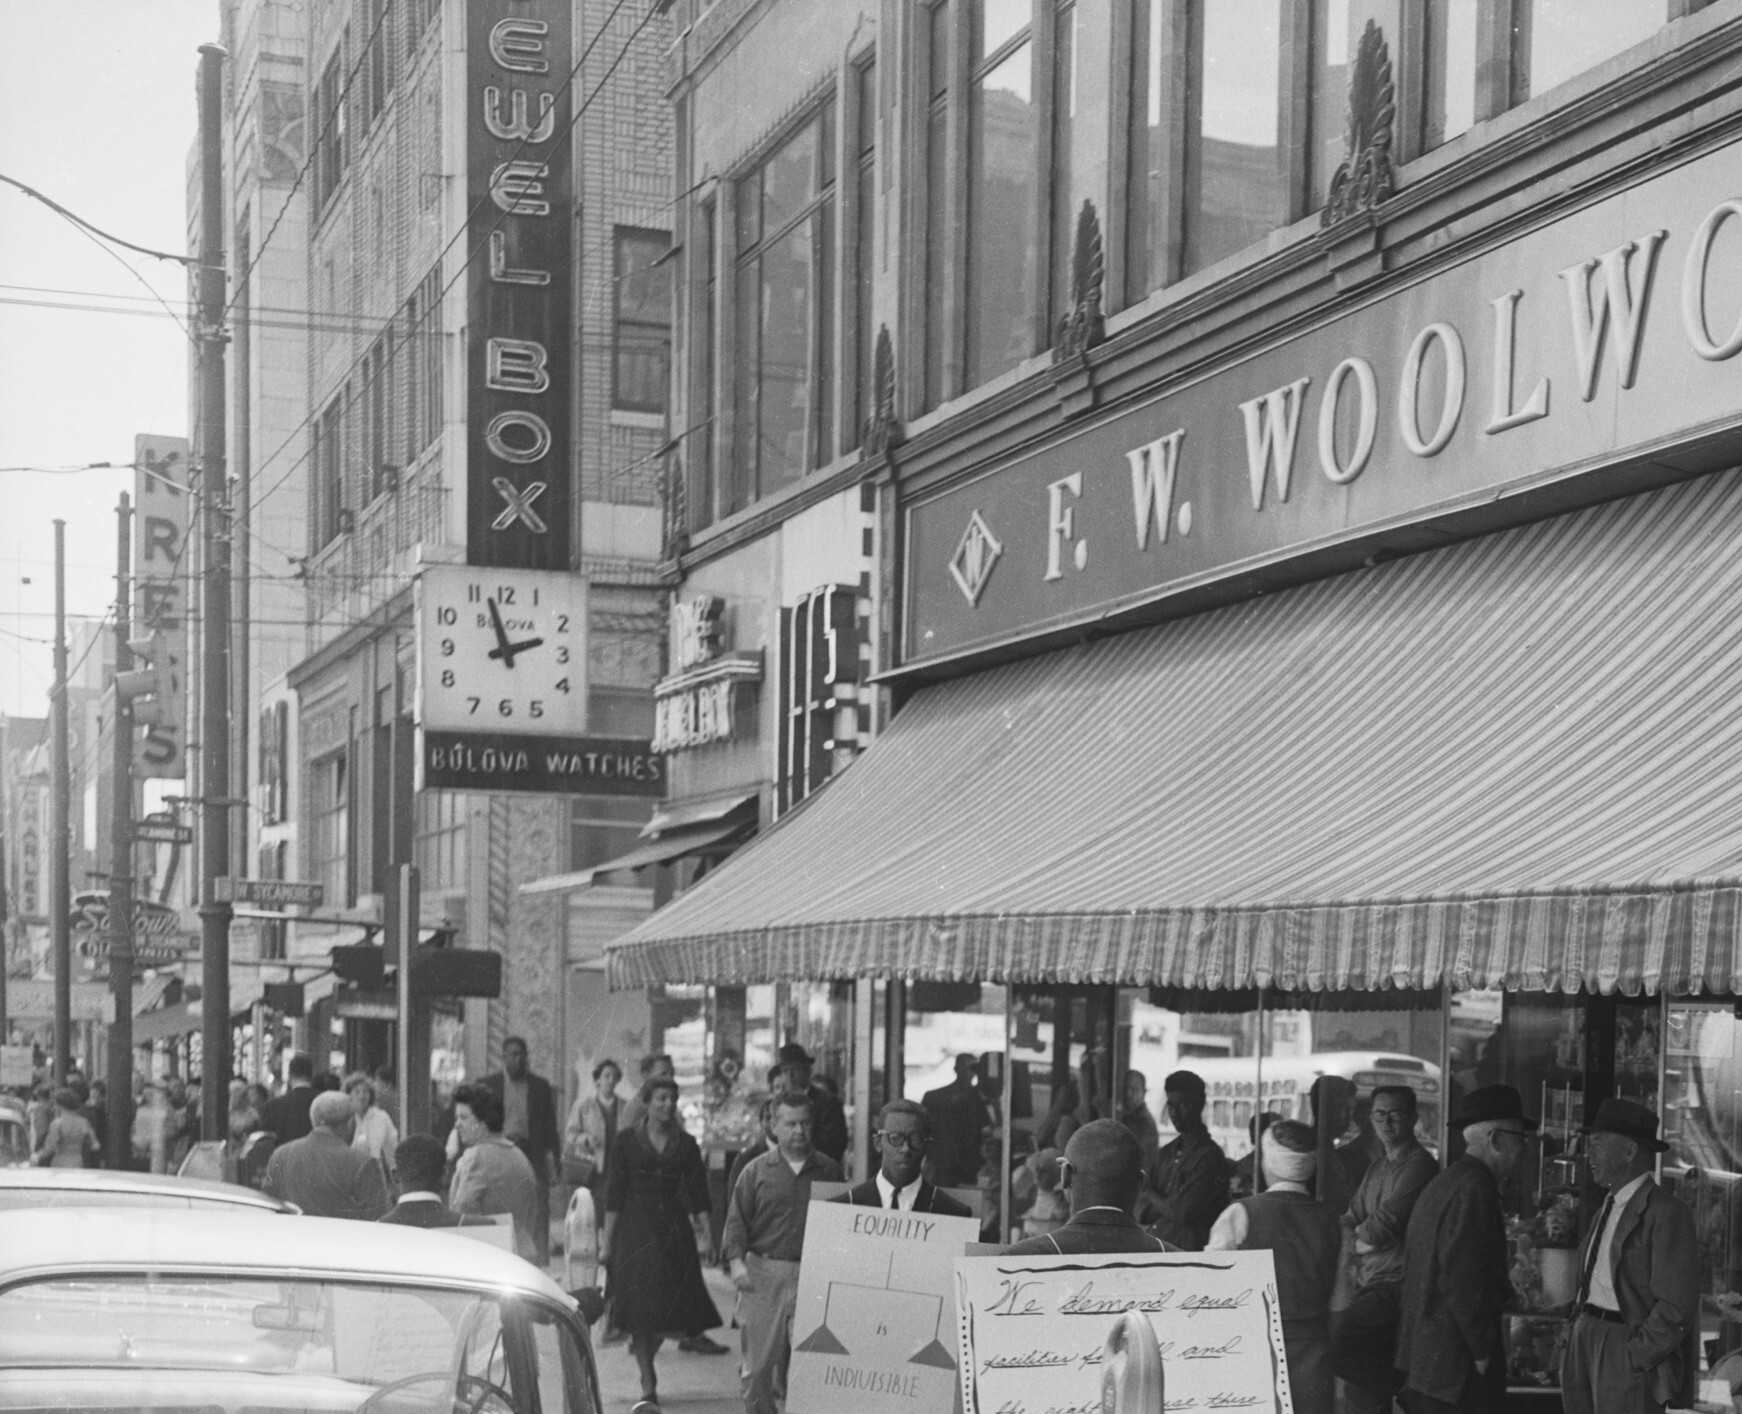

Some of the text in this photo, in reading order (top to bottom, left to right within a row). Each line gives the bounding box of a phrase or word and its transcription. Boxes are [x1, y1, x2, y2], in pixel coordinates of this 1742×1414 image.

[484, 16, 555, 286] EWEL
[484, 336, 552, 535] BOX
[1043, 470, 1090, 583] F.
[1125, 427, 1193, 553] W.
[498, 586, 516, 605] 12
[533, 588, 539, 606] 1
[143, 448, 181, 767] KRES
[437, 606, 457, 626] 10
[476, 613, 535, 631] BOVA
[557, 615, 570, 633] 2
[441, 638, 455, 656] 9
[557, 646, 570, 664] 3
[441, 670, 455, 688] 8
[555, 677, 570, 694] 4
[466, 697, 480, 714] 7
[499, 699, 513, 717] 6
[529, 701, 543, 718] 5
[547, 752, 661, 781] WATCHES
[852, 1213, 935, 1242] EQUALITY
[984, 1279, 1253, 1318] We demand equal
[875, 1320, 888, 1337] is
[1177, 1336, 1244, 1358] and
